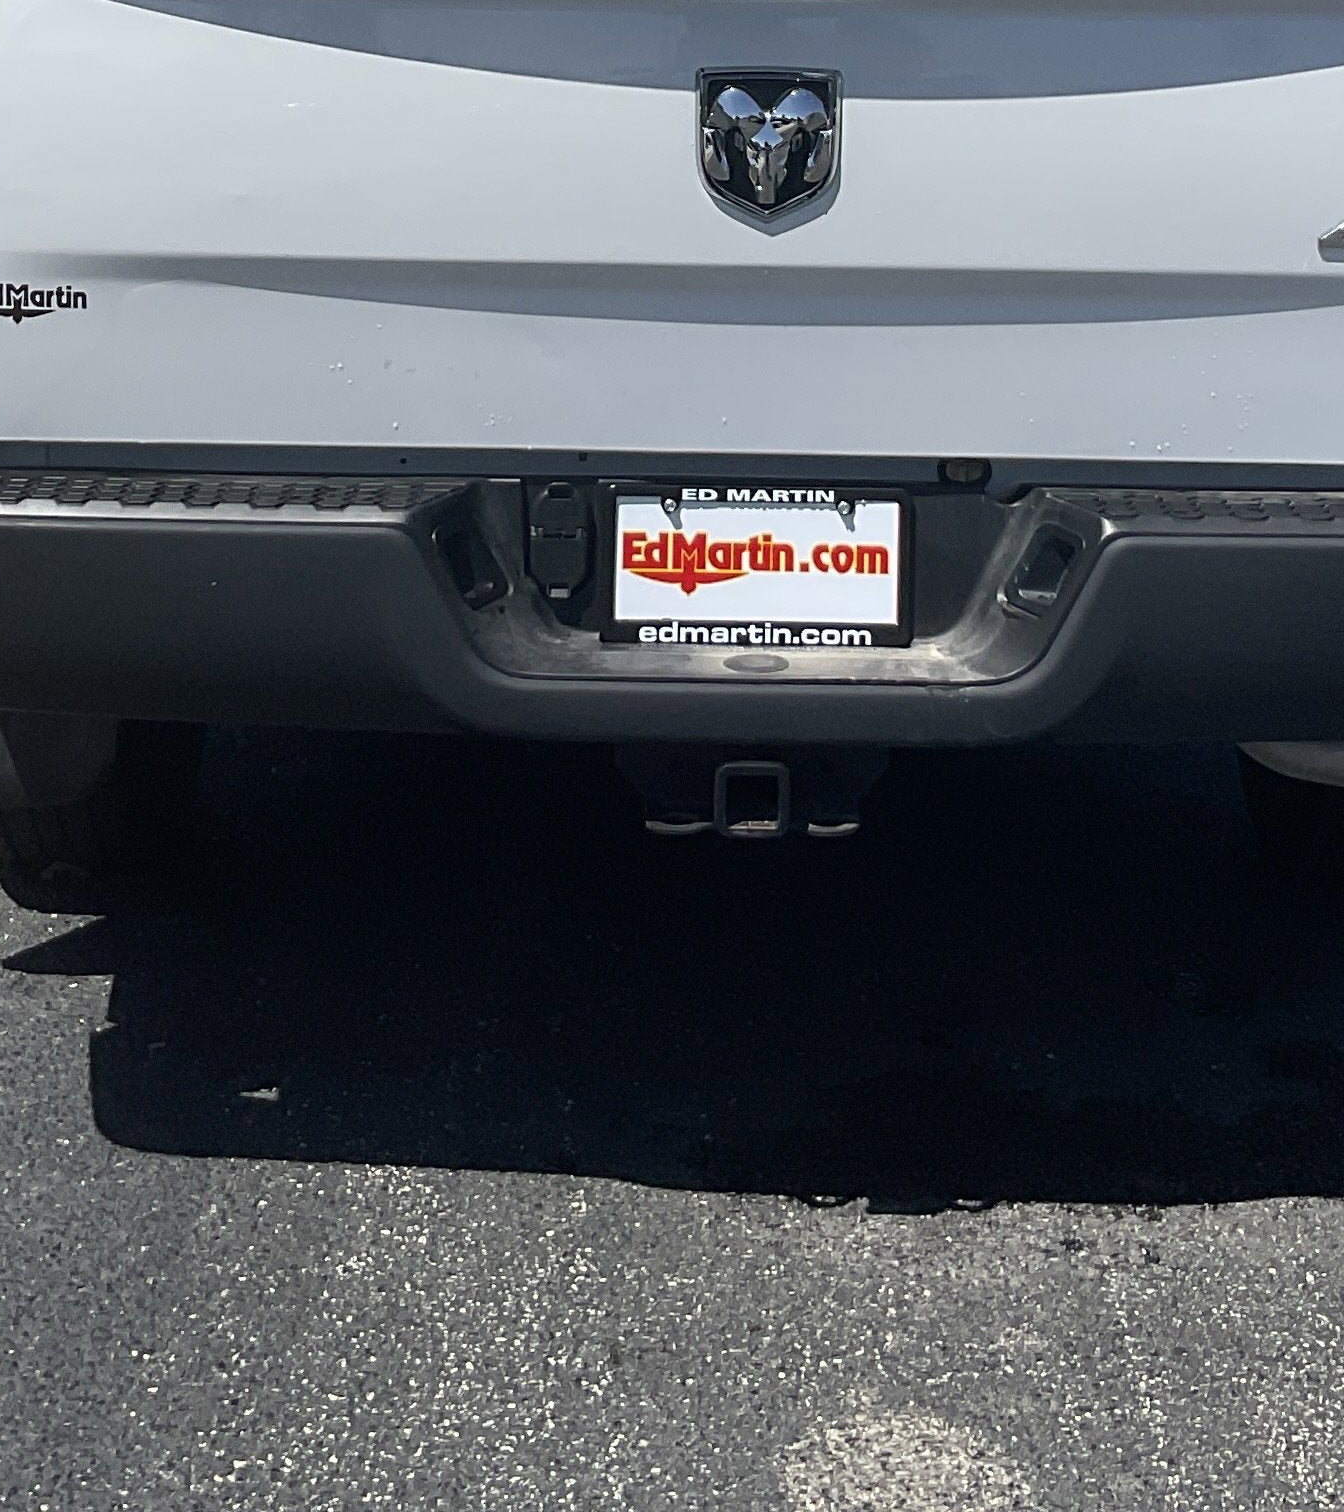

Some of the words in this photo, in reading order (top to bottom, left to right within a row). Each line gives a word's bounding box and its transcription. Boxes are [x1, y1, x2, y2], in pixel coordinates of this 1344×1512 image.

[681, 488, 718, 502] ED
[726, 488, 836, 503] MARTIN
[638, 622, 873, 647] edmartin.com
